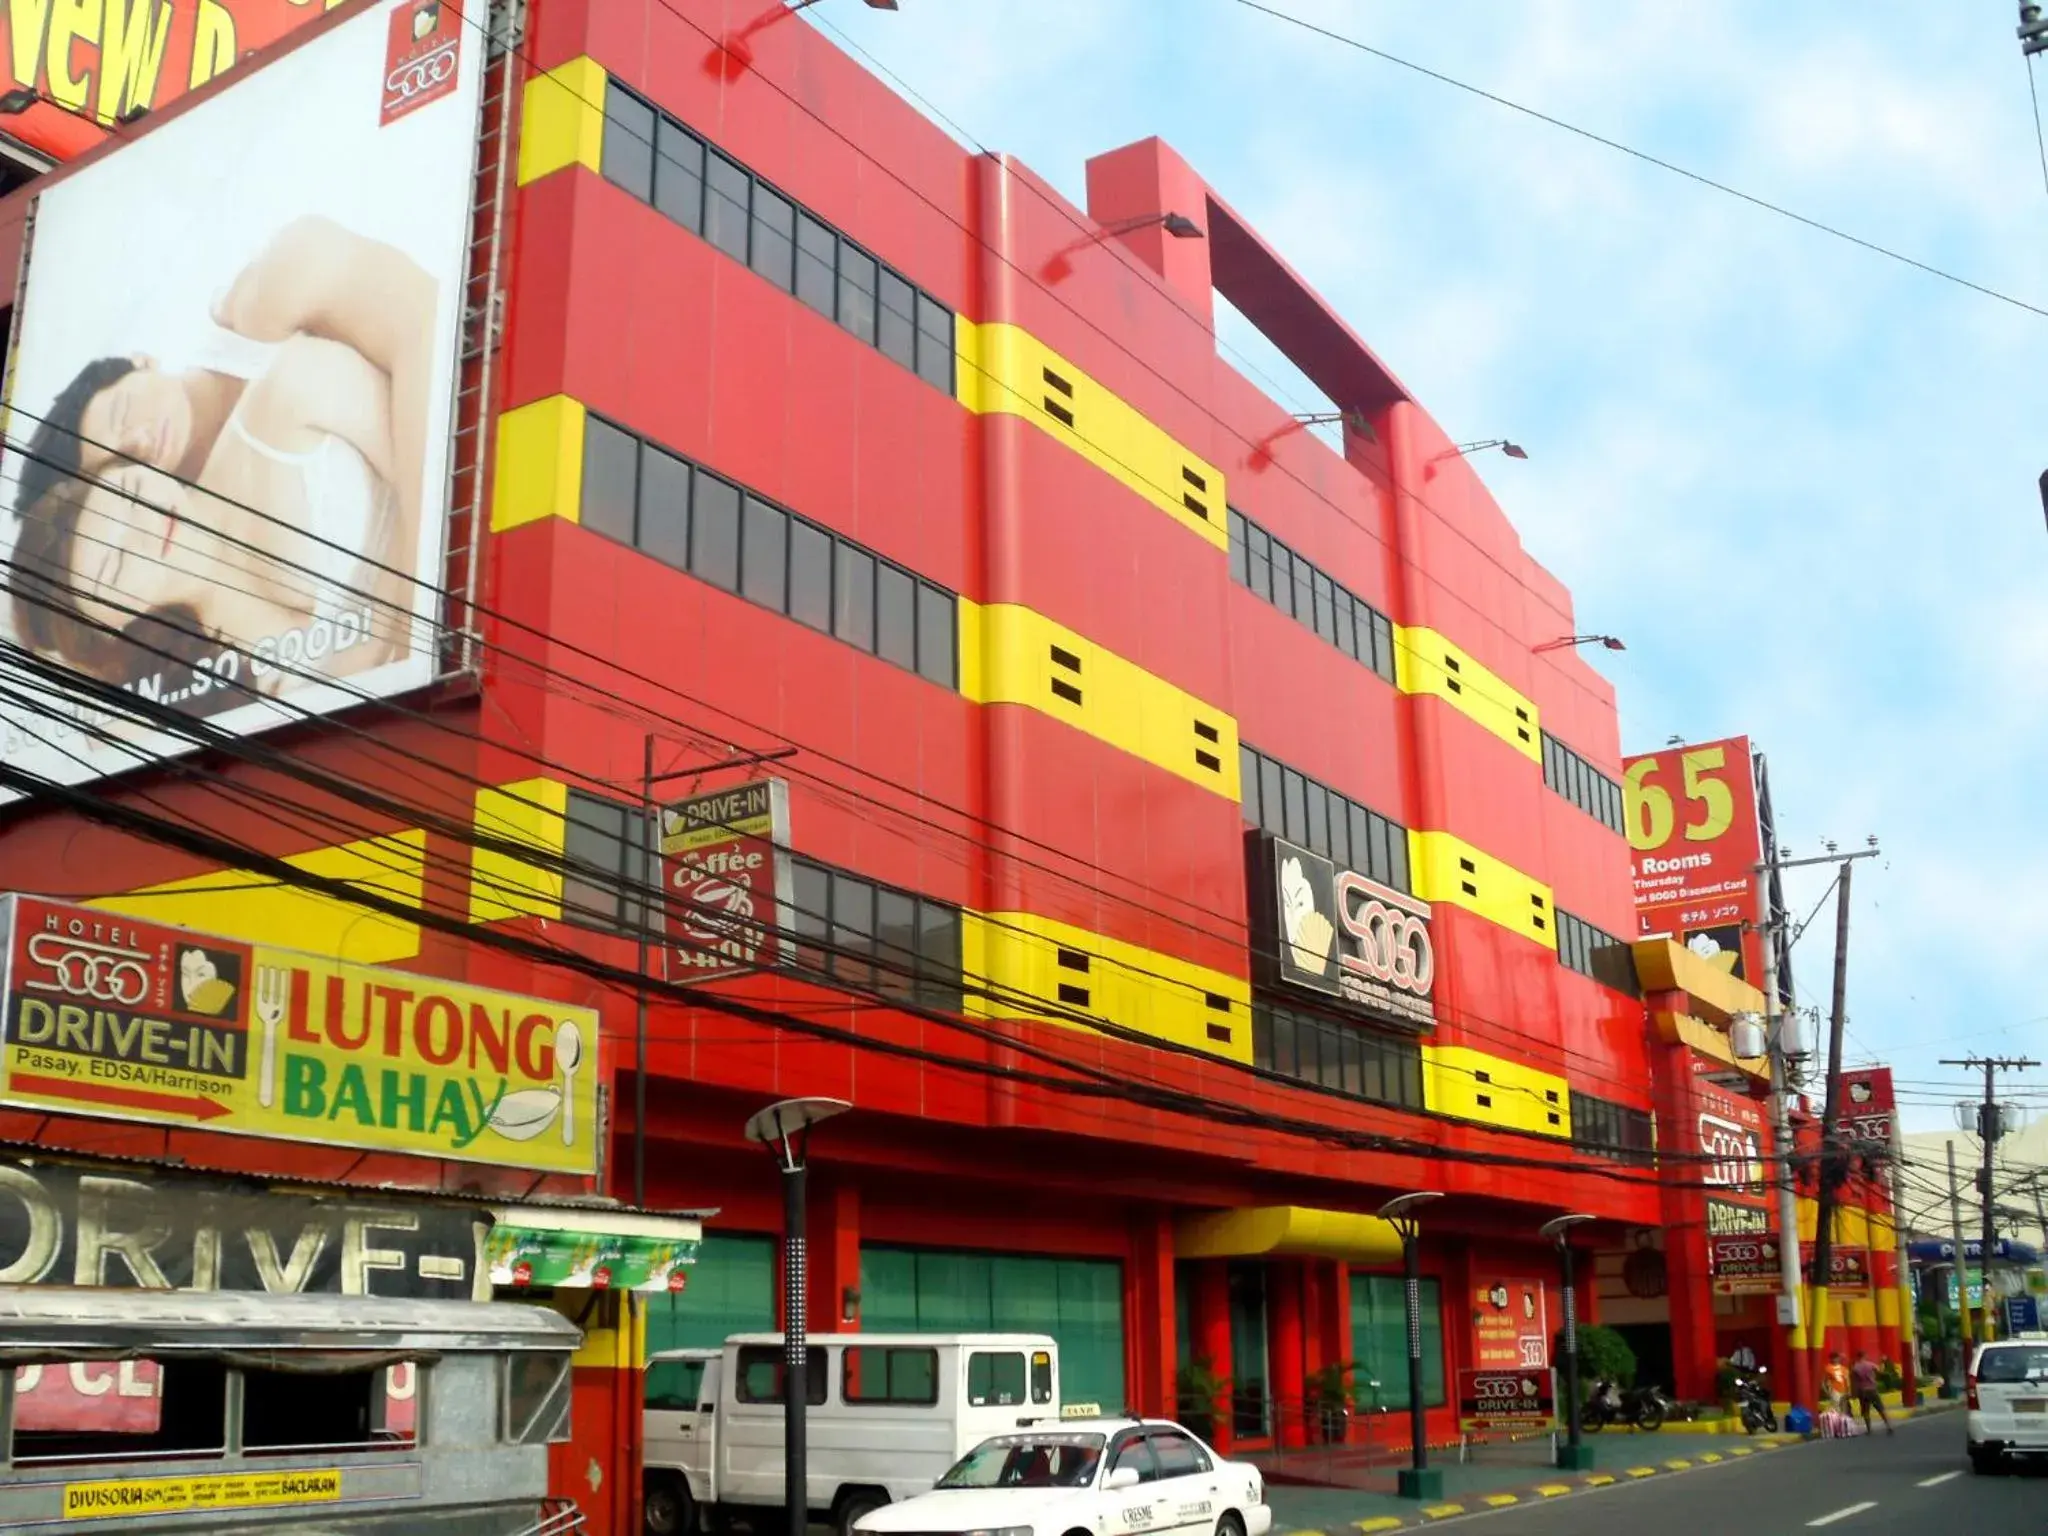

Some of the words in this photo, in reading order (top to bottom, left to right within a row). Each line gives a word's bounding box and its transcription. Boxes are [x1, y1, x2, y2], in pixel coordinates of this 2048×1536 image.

[386, 39, 459, 108] SOGO
[250, 604, 374, 678] GOOD!
[686, 787, 768, 827] DRIVE-IN
[673, 852, 764, 888] Coffee
[1642, 852, 1712, 874] Rooms
[1634, 876, 1684, 890] Thursday
[1649, 889, 1678, 902] SOGO
[1679, 884, 1722, 897] Discount
[1723, 879, 1748, 891] Card
[46, 914, 138, 947] HOTEL
[1334, 870, 1435, 996] SOGO
[25, 933, 151, 1004] SOGO
[17, 998, 236, 1074] DRIVE-IN
[288, 968, 554, 1081] LUTONG
[90, 1060, 233, 1096] EDSA/Harrison
[283, 1054, 507, 1149] BAHAY
[1708, 1201, 1767, 1235] DRIVE-IN
[1473, 1376, 1518, 1398] SOGO
[1477, 1399, 1538, 1411] DRIVE-IN
[68, 1485, 143, 1510] DIVISORIA
